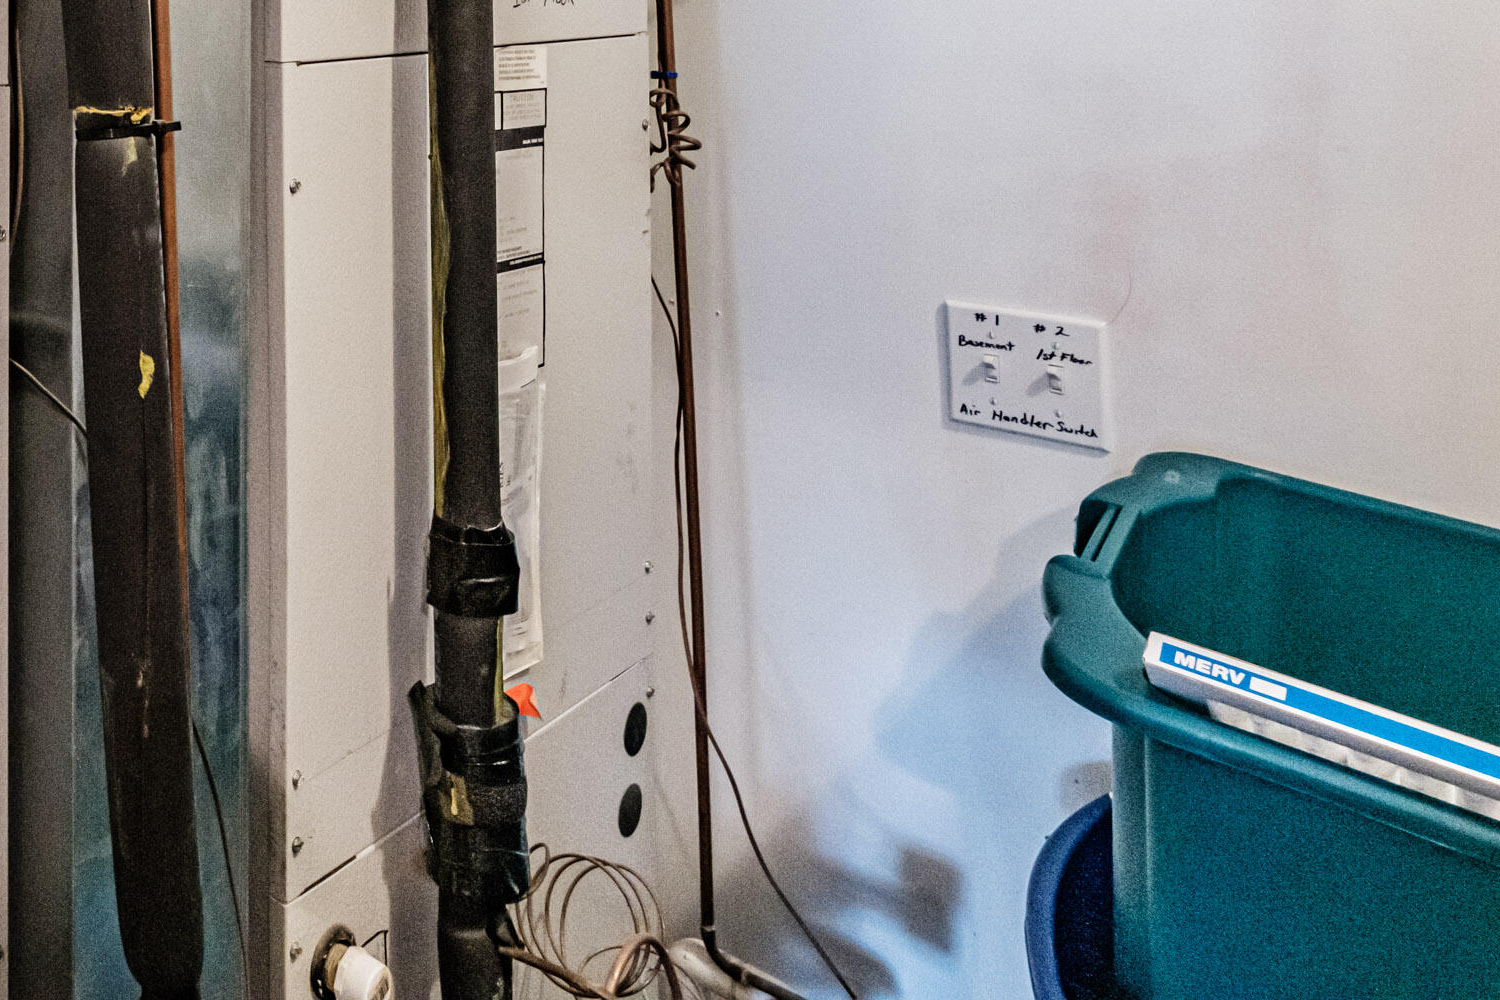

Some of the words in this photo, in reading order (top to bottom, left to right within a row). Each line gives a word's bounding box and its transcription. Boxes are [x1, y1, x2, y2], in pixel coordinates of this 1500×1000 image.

[958, 334, 1016, 351] Basement
[1036, 348, 1056, 361] 1st
[1060, 352, 1093, 366] Floor
[960, 404, 981, 416] Air
[992, 410, 1053, 430] Handler
[1055, 422, 1099, 438] Switch
[1173, 650, 1247, 686] MERV
